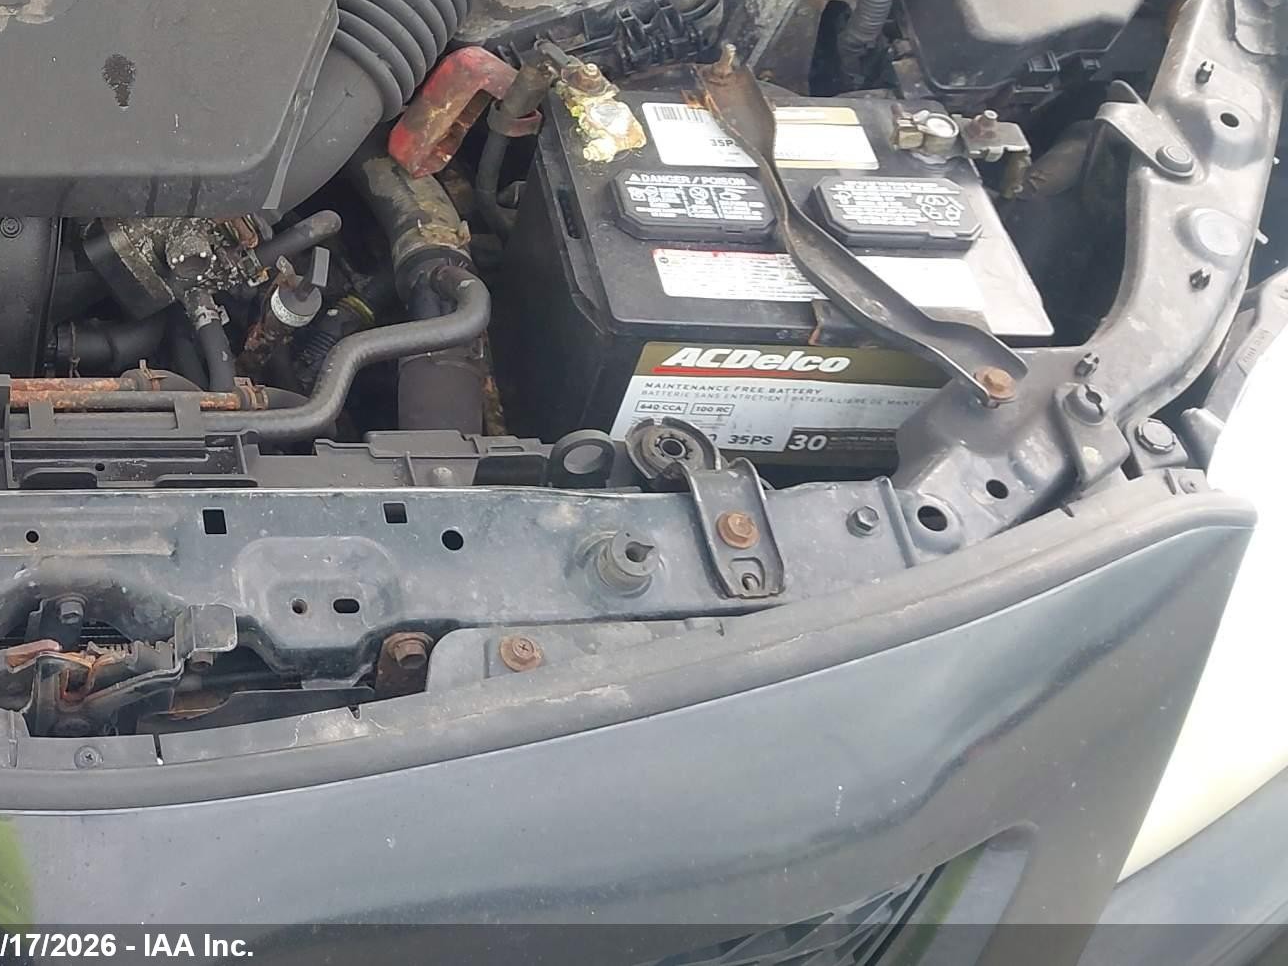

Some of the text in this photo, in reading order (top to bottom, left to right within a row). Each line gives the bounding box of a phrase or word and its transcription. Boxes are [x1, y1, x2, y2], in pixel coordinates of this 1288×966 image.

[640, 175, 690, 184] DANGER
[703, 177, 747, 185] POISON
[661, 347, 850, 373] ACDelco
[644, 382, 730, 392] MAINTENANCE
[641, 390, 690, 398] BATTERIE
[724, 393, 781, 401] ENTRETIEN
[728, 435, 774, 445] 35PS
[788, 434, 828, 450] 30
